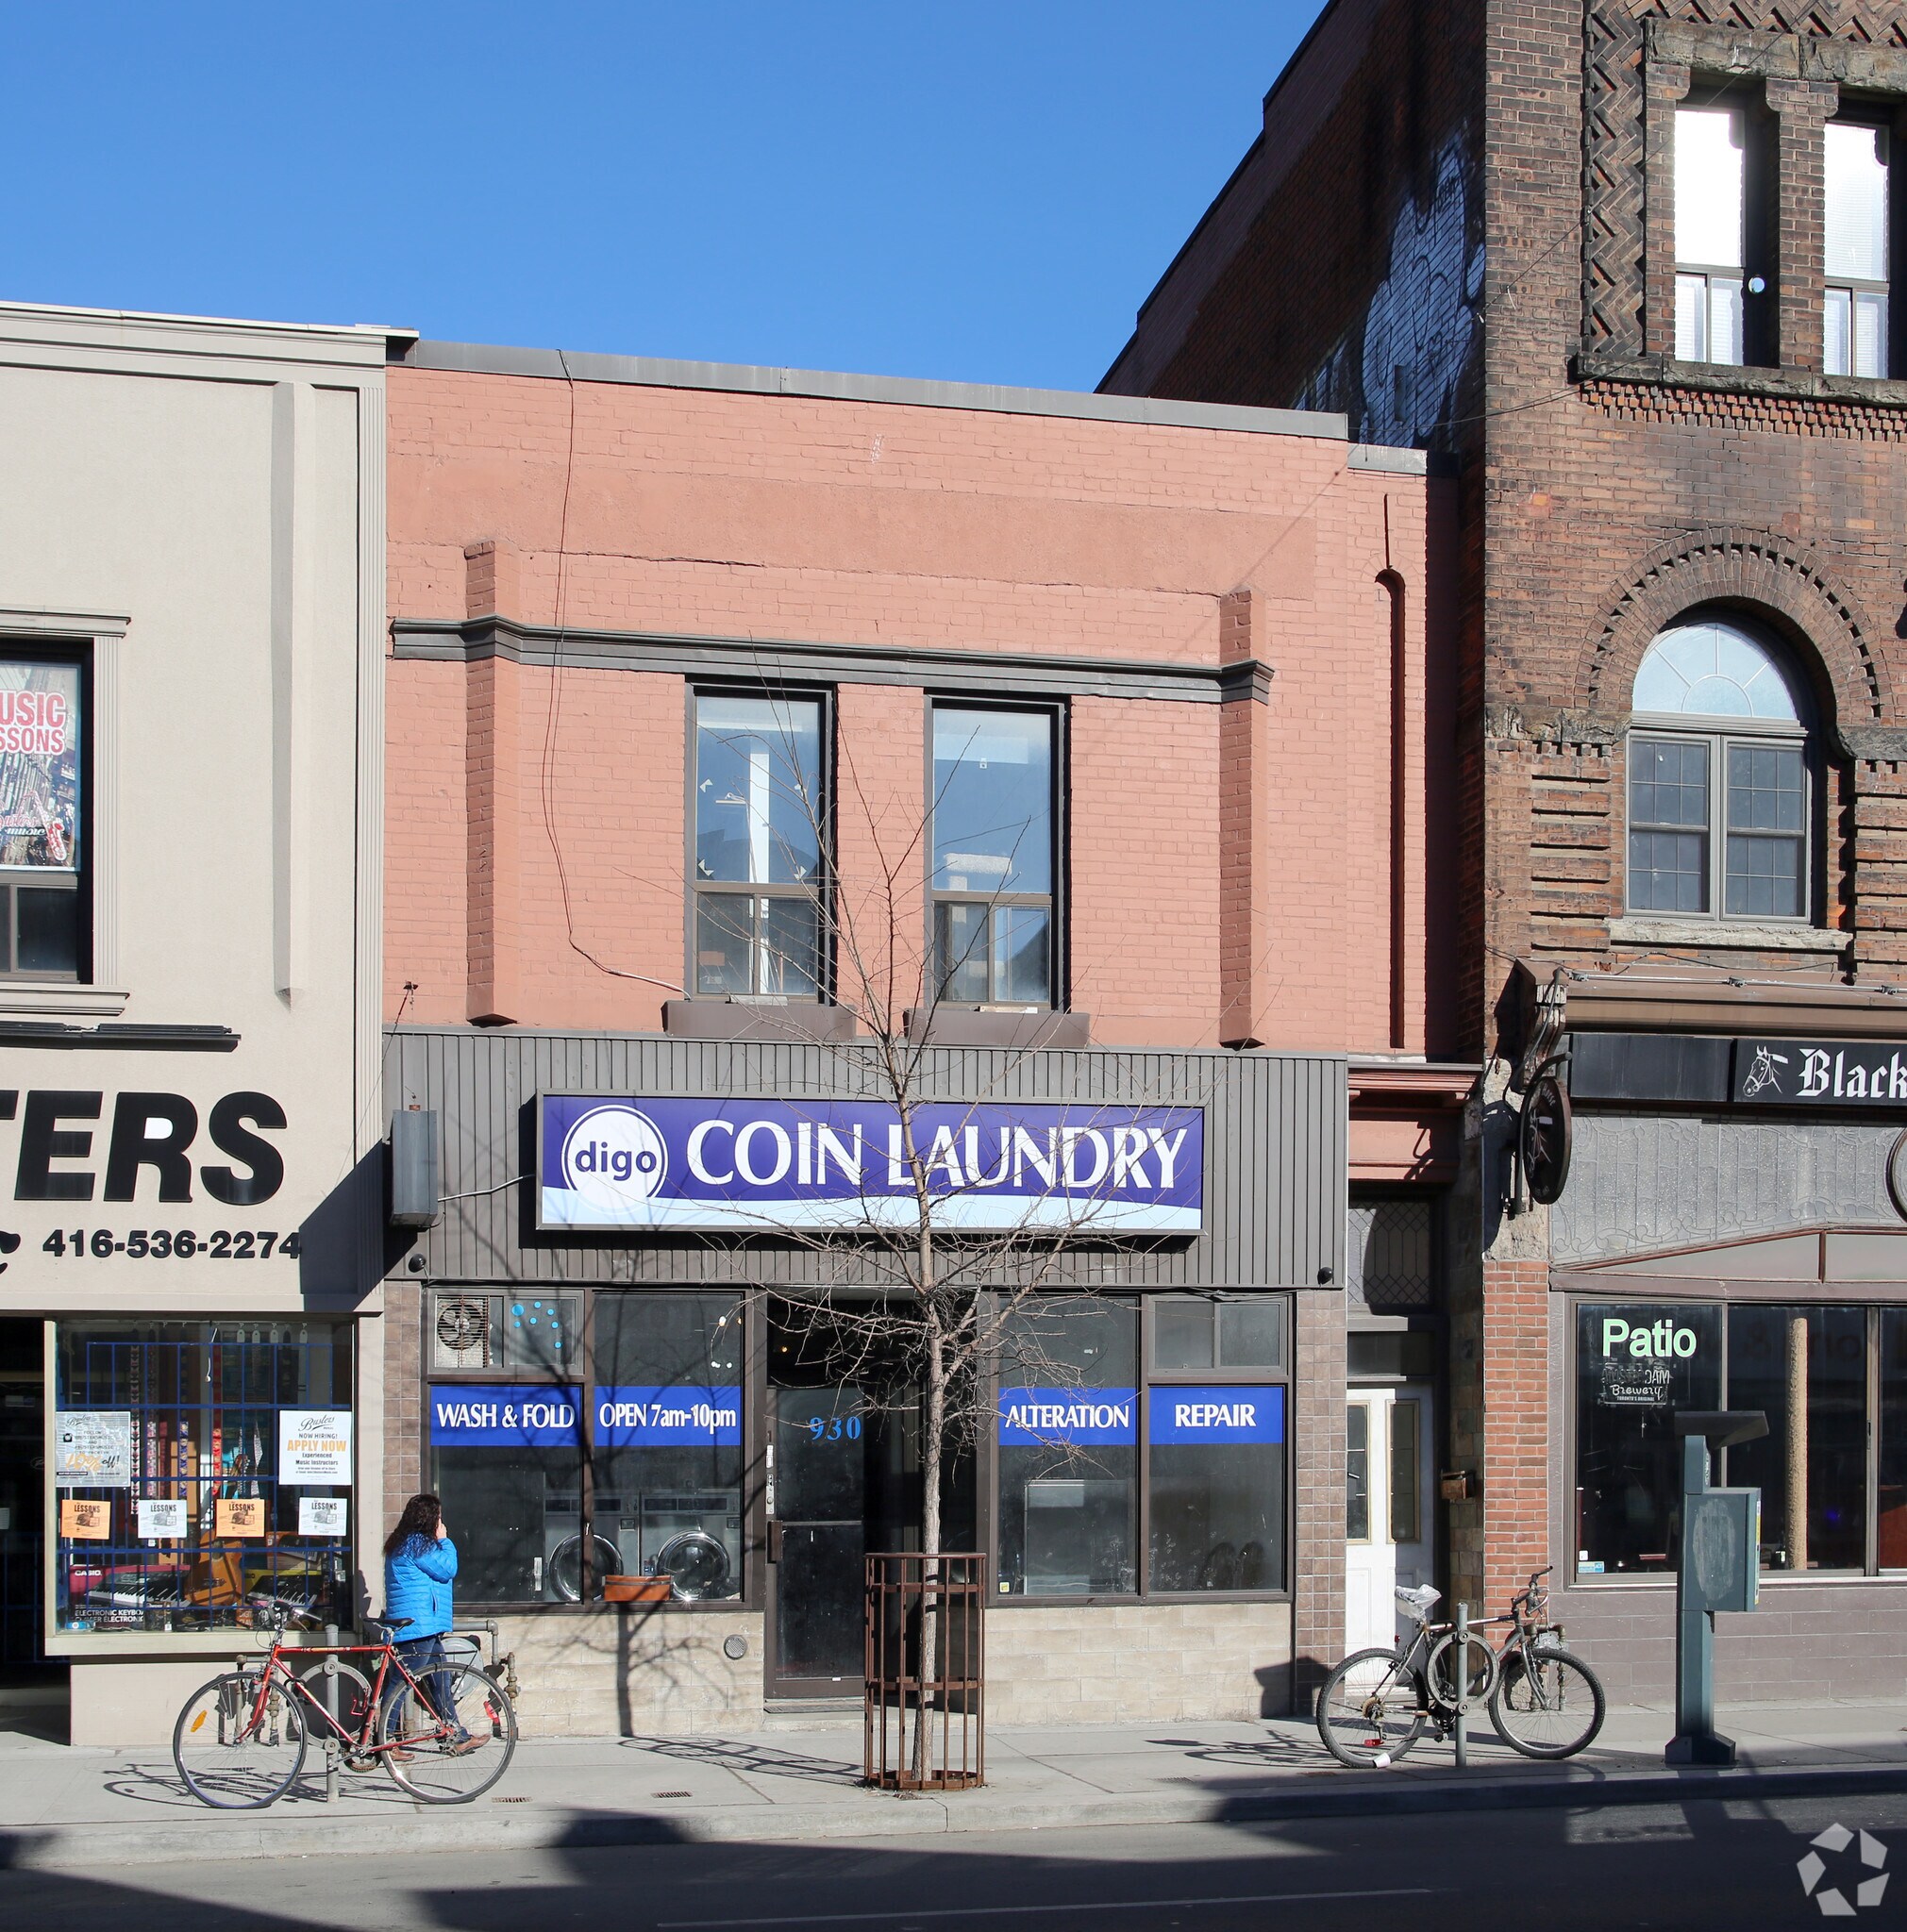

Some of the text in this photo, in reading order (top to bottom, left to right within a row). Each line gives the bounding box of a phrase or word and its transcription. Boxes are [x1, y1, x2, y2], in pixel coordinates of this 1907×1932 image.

[1796, 1048, 1907, 1098] Black
[0, 1090, 287, 1206] ERS
[687, 1120, 1187, 1189] COIN LAUNDRY
[576, 1141, 658, 1182] digo
[42, 1229, 301, 1258] 416-536-2274
[1603, 1318, 1697, 1357] Patio
[1610, 1384, 1664, 1400] Brewery
[298, 1414, 335, 1432] Busters
[437, 1403, 575, 1428] WASH & FOLD
[599, 1403, 736, 1435] OPEN 7am-10pm
[1005, 1405, 1129, 1428] ALTERATION
[1175, 1404, 1257, 1427] REPAIR
[810, 1416, 861, 1441] 930
[287, 1439, 347, 1453] APPLY NOW
[75, 1504, 101, 1513] LESSONS
[150, 1504, 177, 1513] LESSONS
[228, 1503, 255, 1511] LESSONS
[311, 1502, 337, 1510] LESSONS
[75, 1608, 115, 1617] ELECTRONIC
